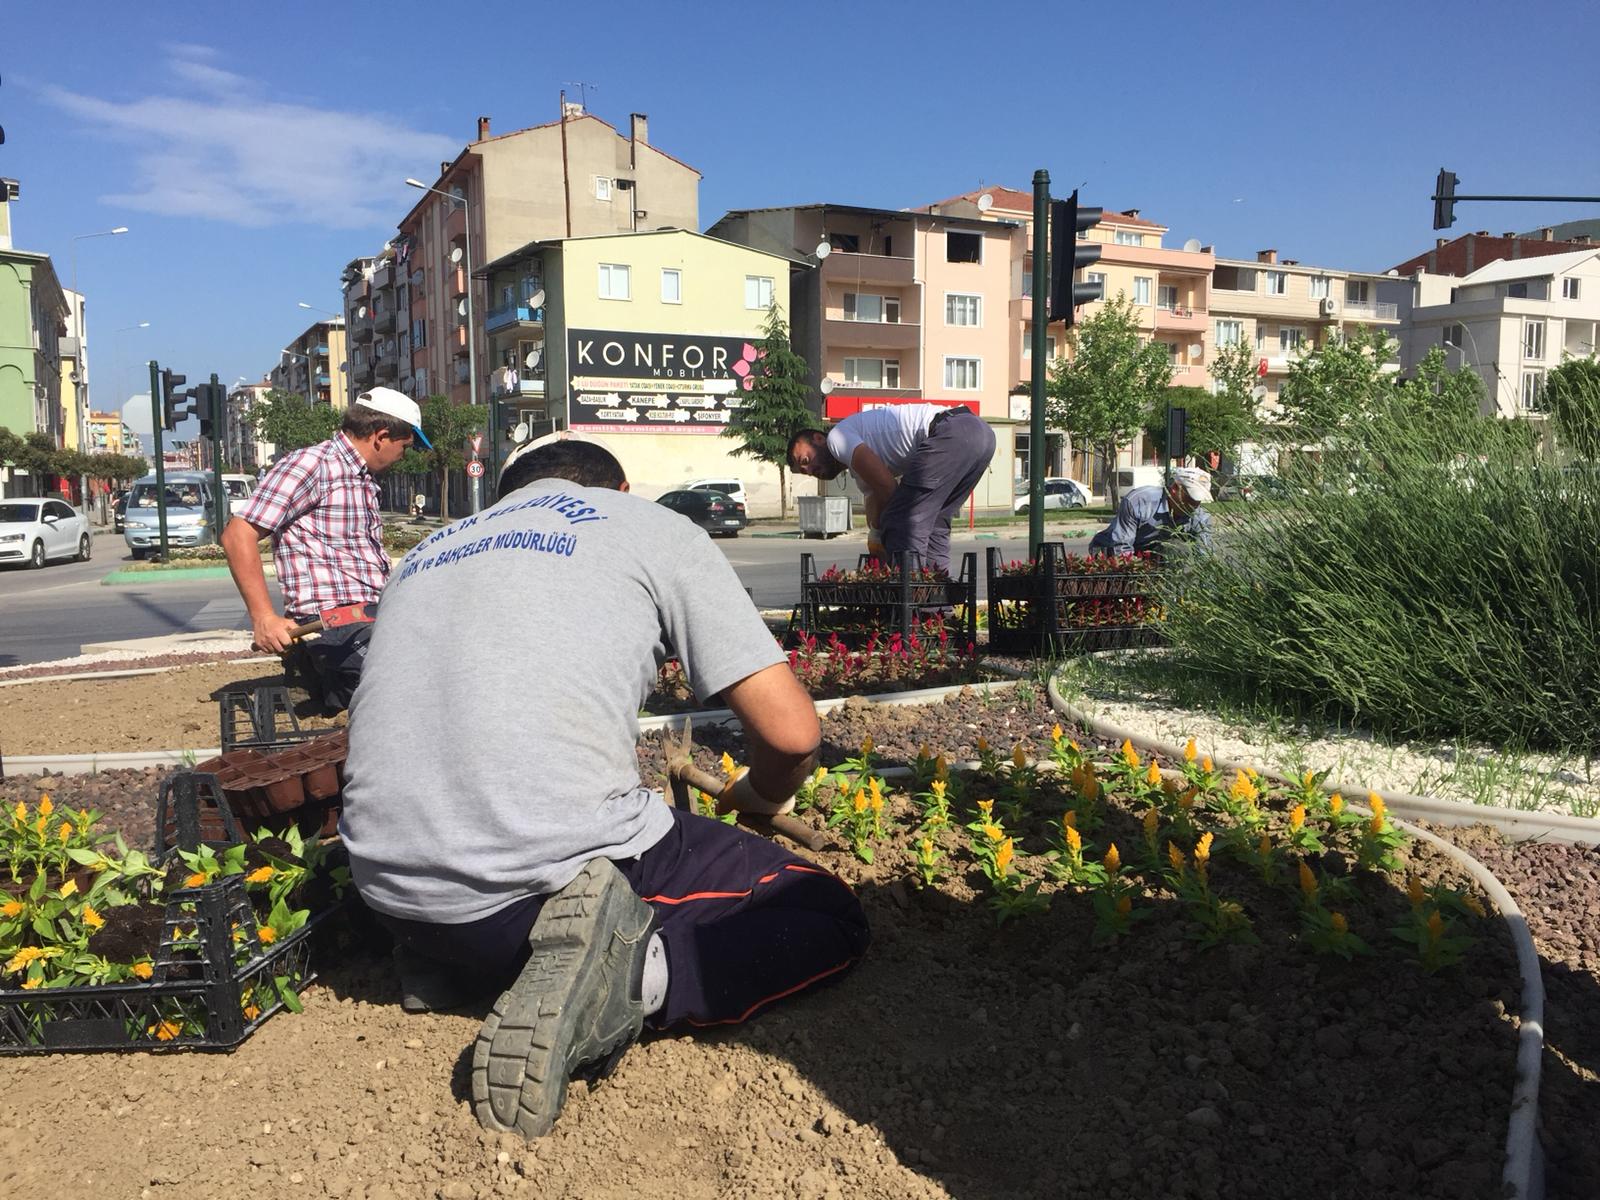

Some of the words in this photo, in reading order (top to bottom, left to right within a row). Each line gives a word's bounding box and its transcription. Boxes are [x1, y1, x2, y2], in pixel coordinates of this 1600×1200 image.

[577, 340, 728, 370] KONFOR
[653, 367, 729, 379] MOBİLYA
[631, 396, 655, 405] KANEPE
[471, 465, 480, 473] 30
[421, 557, 434, 572] ve
[434, 536, 493, 565] BAHÇELER
[492, 528, 577, 557] MÜDÜRLÜĞÜ
